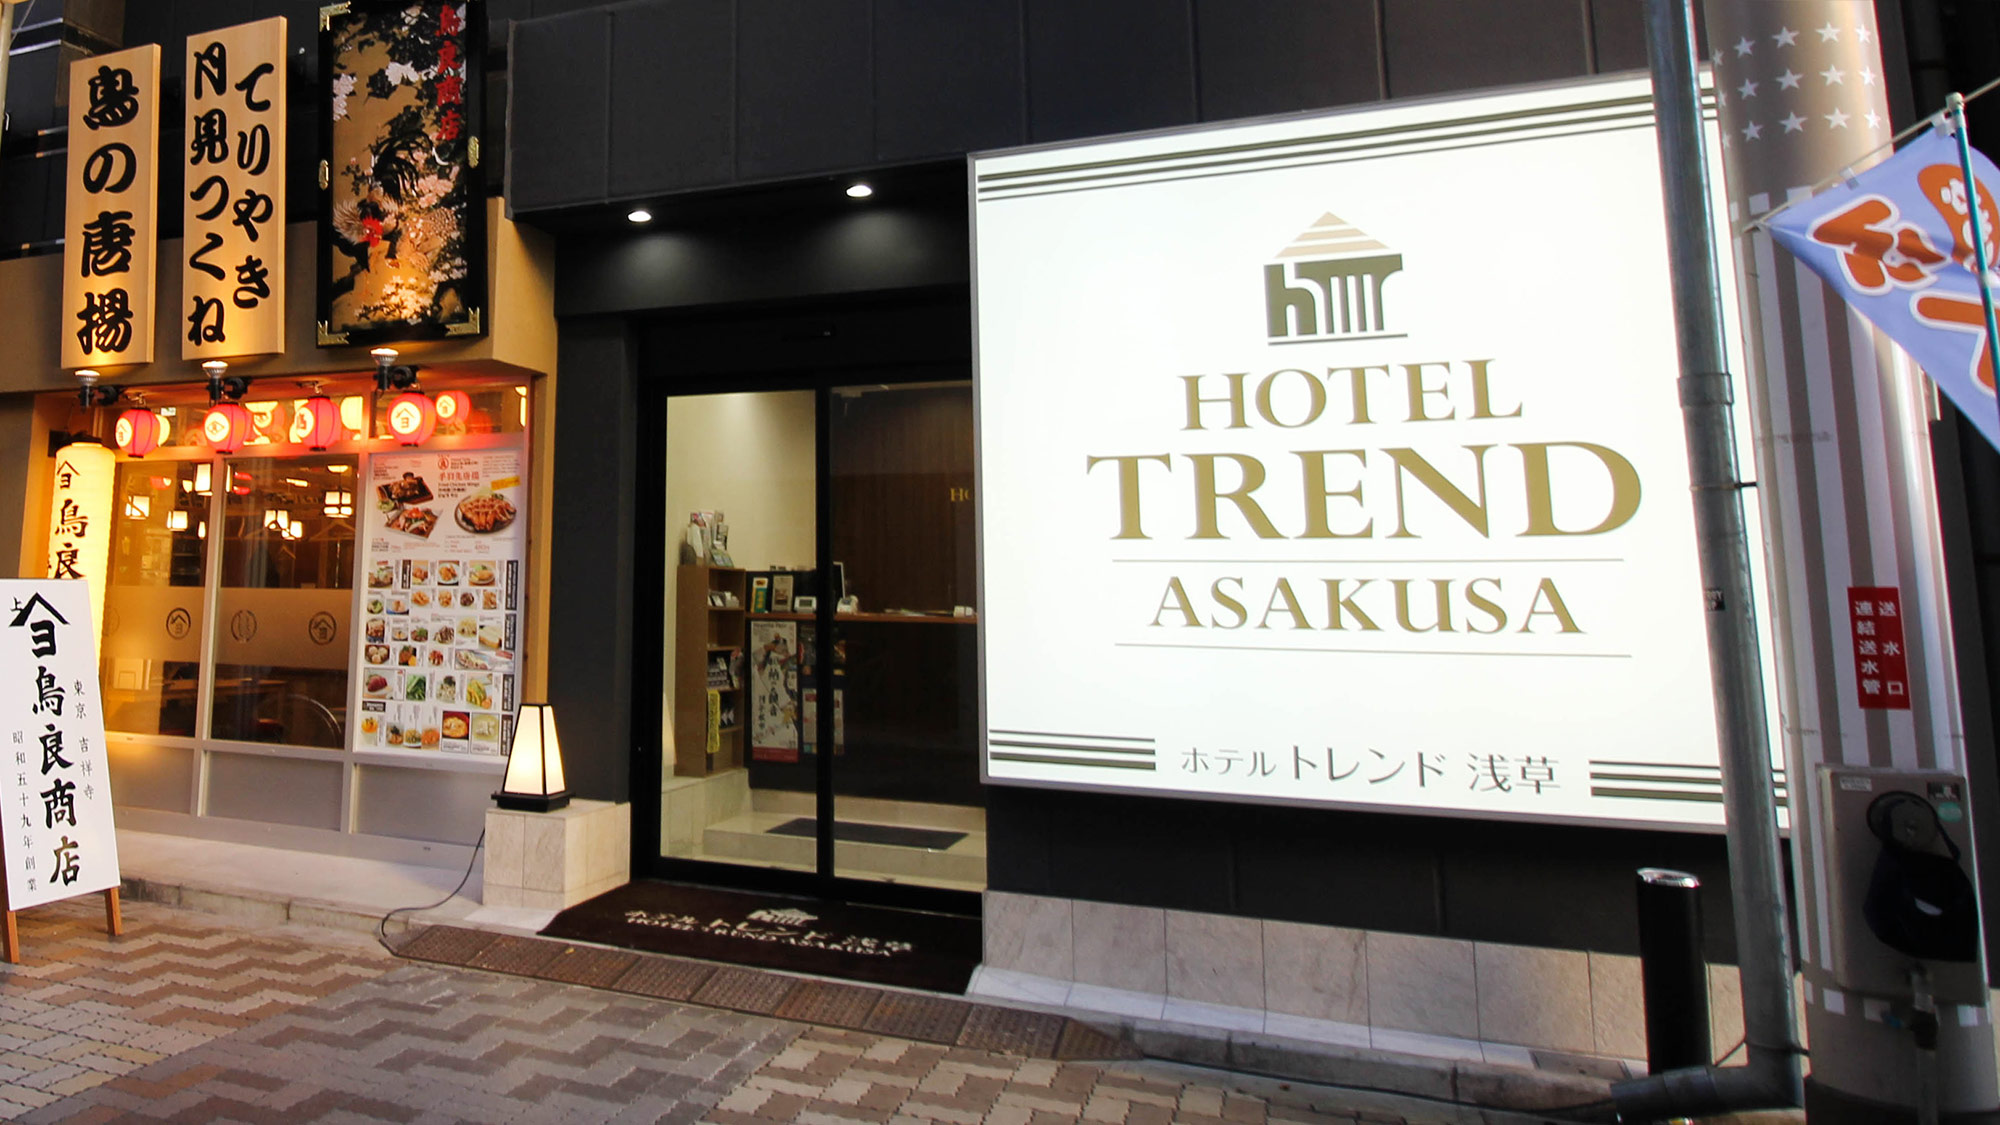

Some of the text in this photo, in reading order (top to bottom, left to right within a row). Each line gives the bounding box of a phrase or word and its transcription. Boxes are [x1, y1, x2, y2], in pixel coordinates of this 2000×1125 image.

[77, 65, 139, 355] 鳥の唐揚
[188, 42, 229, 346] 月見つくね
[233, 62, 274, 308] てりやき
[1177, 358, 1523, 430] HOTEL
[1086, 441, 1642, 540] TREND
[1148, 576, 1587, 634] ASAKUSA
[1854, 600, 1881, 695] 連結送水管
[1878, 601, 1904, 695] 送水口
[1181, 744, 1561, 795] ホテル トレンド 浅草
